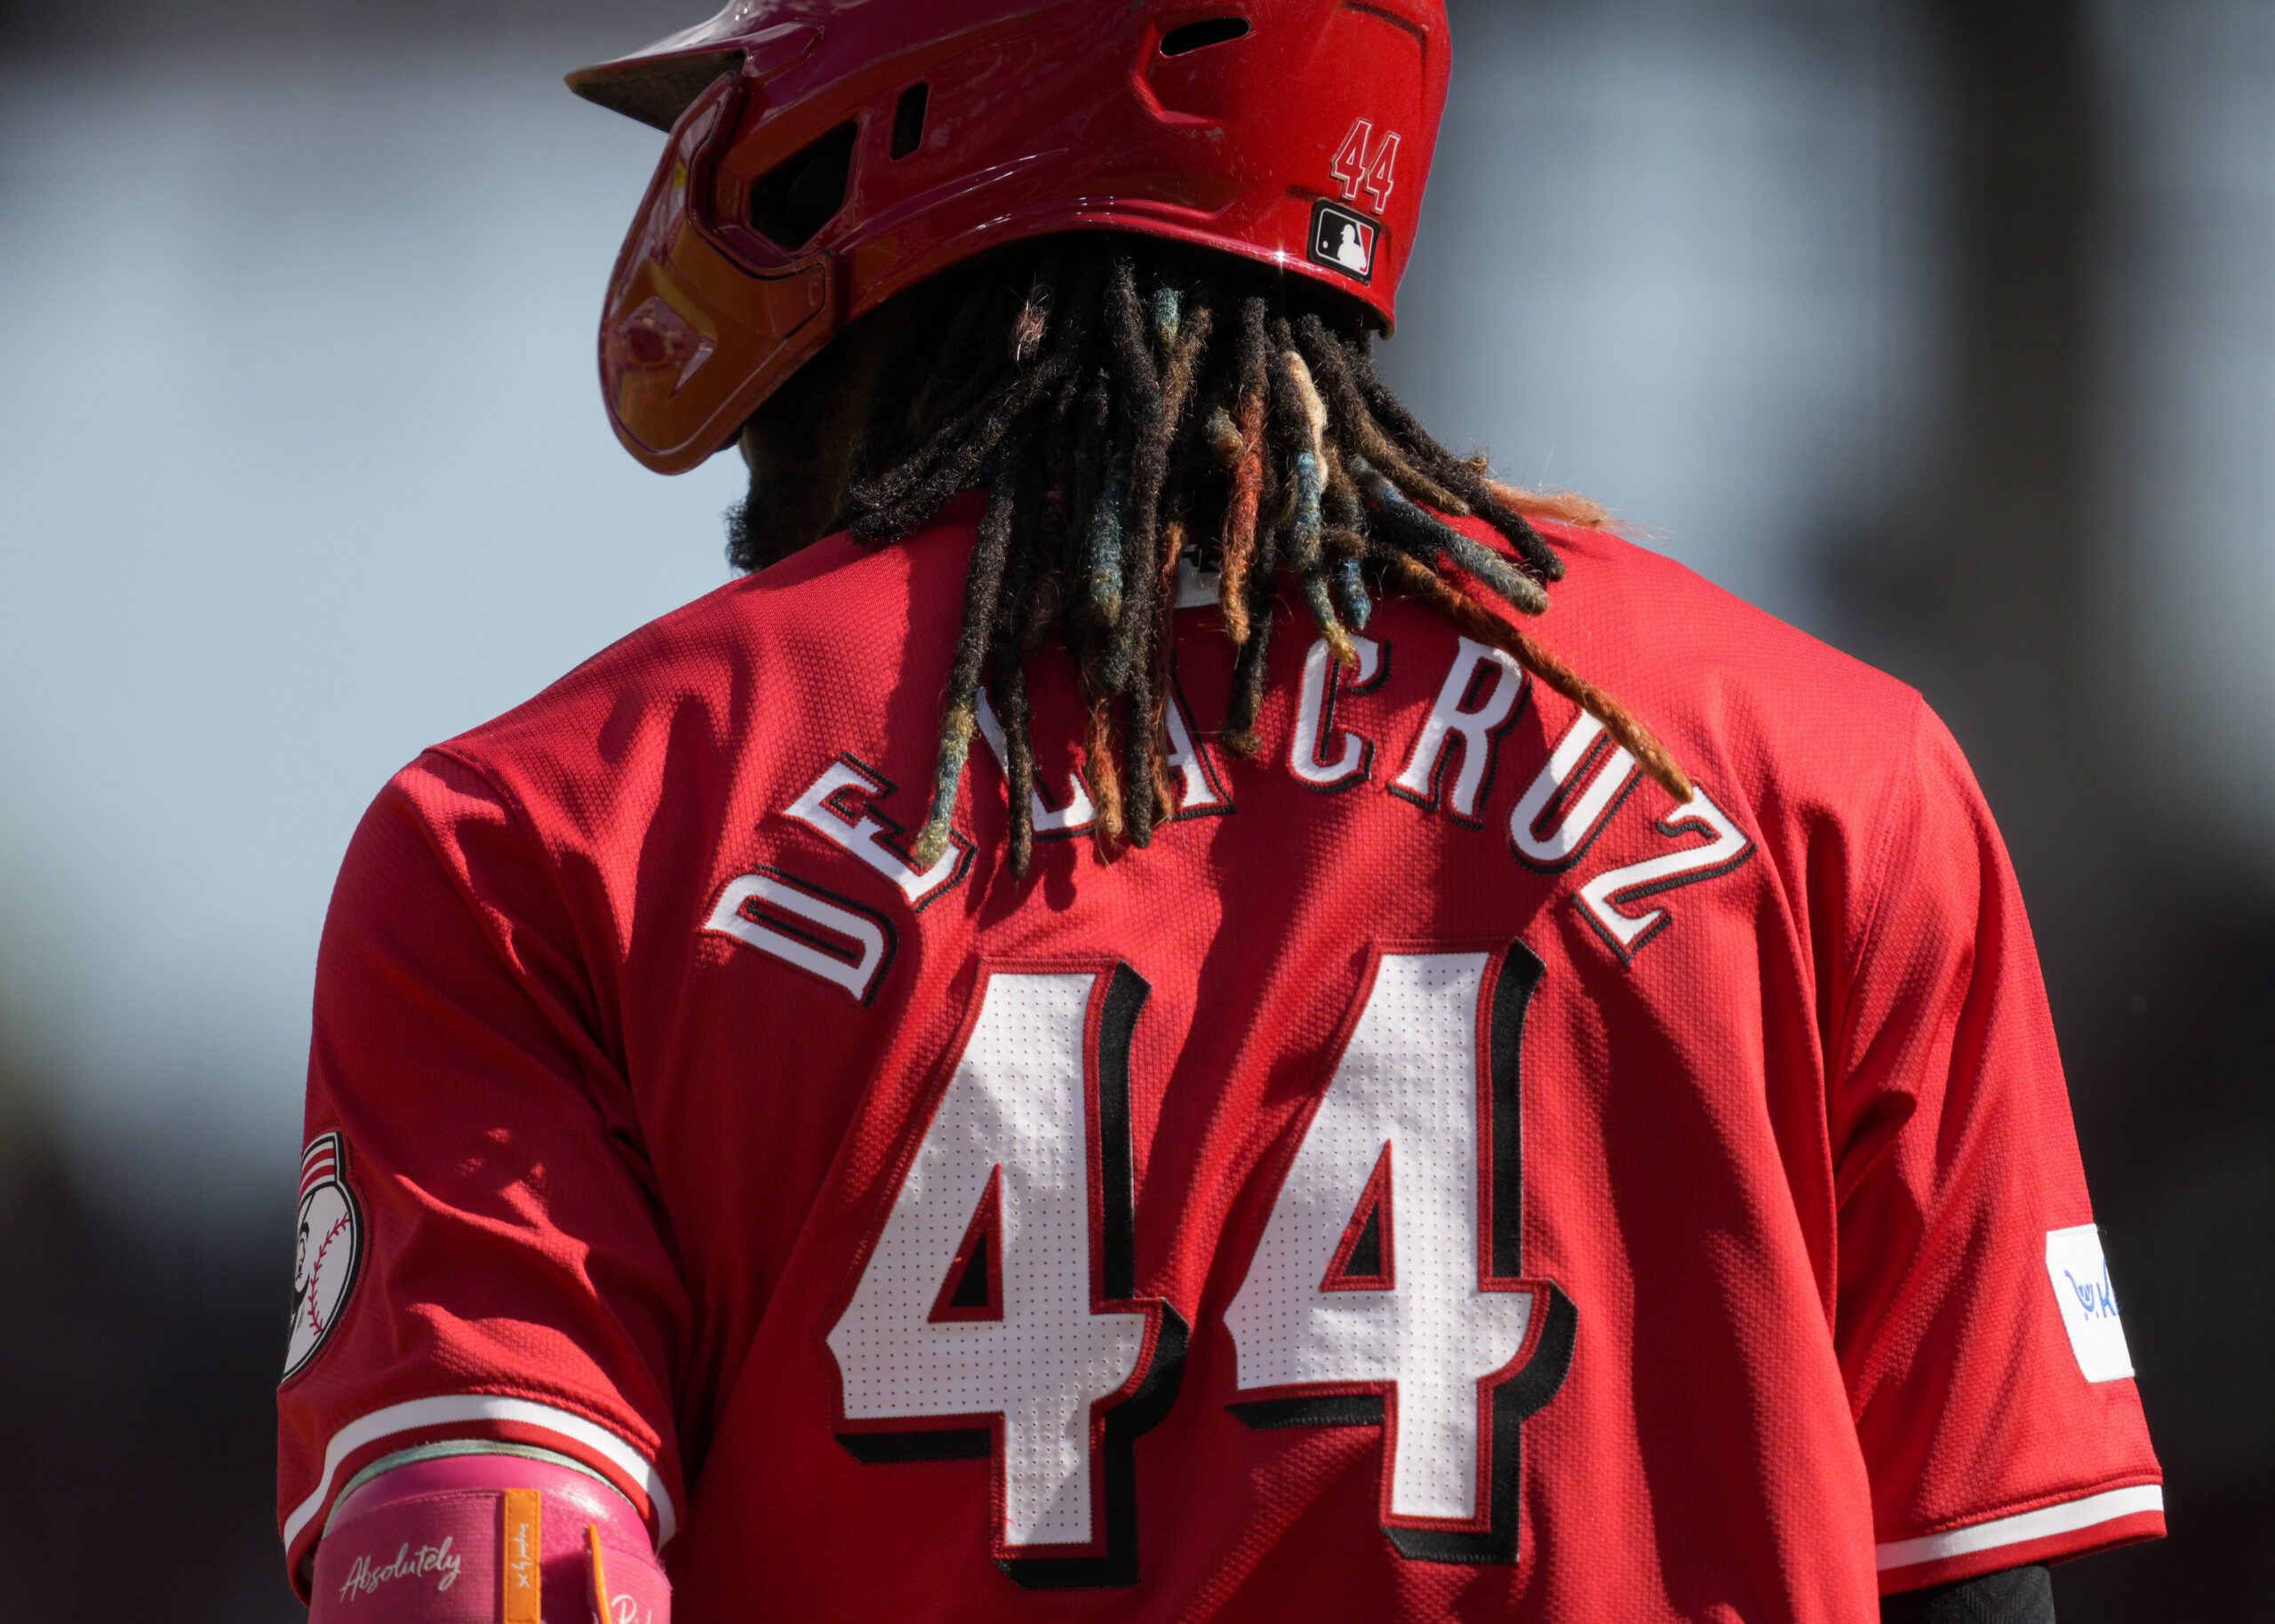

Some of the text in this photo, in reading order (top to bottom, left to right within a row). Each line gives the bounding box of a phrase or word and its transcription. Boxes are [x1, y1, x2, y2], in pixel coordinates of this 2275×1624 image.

[1329, 117, 1401, 215] 44
[698, 752, 978, 1007] DE
[1288, 632, 1757, 965] CRUZ
[821, 937, 1579, 1588] 44
[339, 1535, 461, 1603] Absolutely
